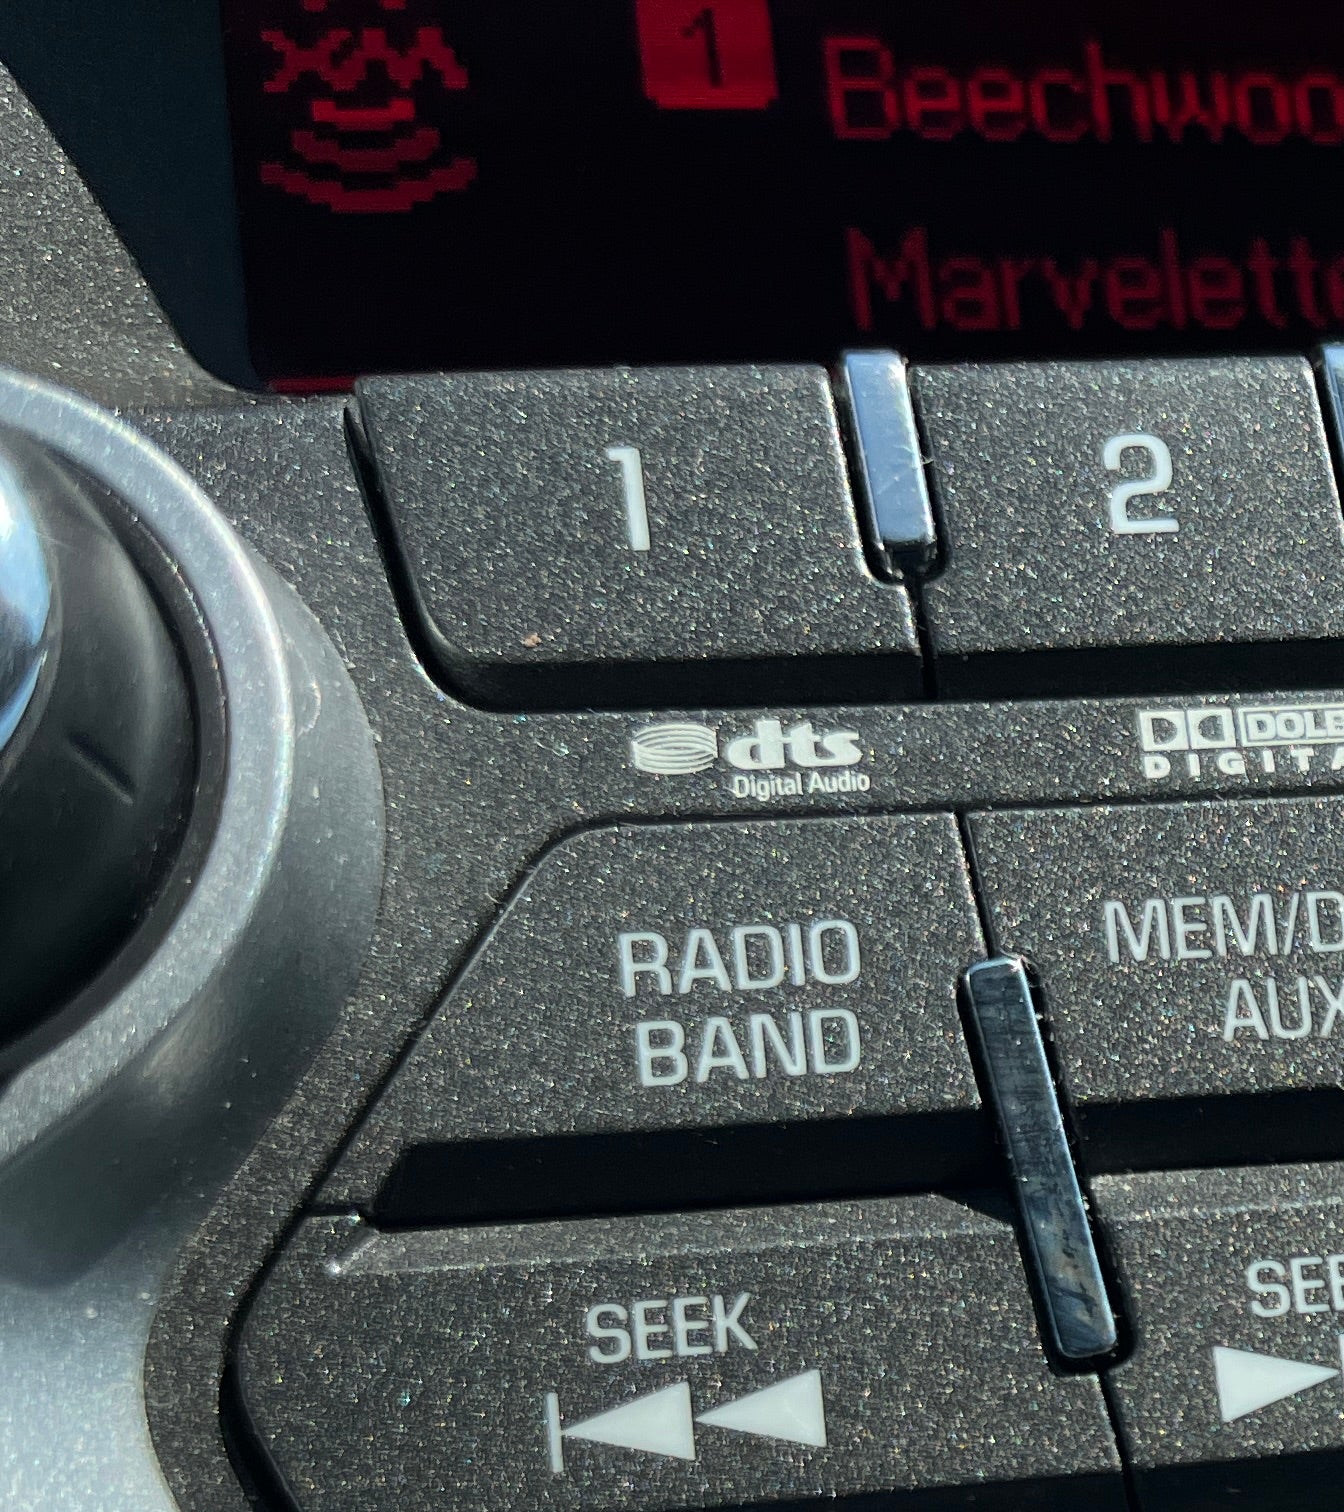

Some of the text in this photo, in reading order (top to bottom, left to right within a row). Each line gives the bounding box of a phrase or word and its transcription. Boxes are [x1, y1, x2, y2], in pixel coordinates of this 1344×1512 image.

[681, 6, 725, 89] 1
[605, 446, 650, 551] 1
[1101, 433, 1180, 535] 2
[727, 719, 863, 771] dts
[733, 770, 871, 801] Digital Audio
[617, 918, 861, 997] RADIO
[634, 1008, 861, 1088] BAND
[586, 1292, 758, 1364] SEEK
